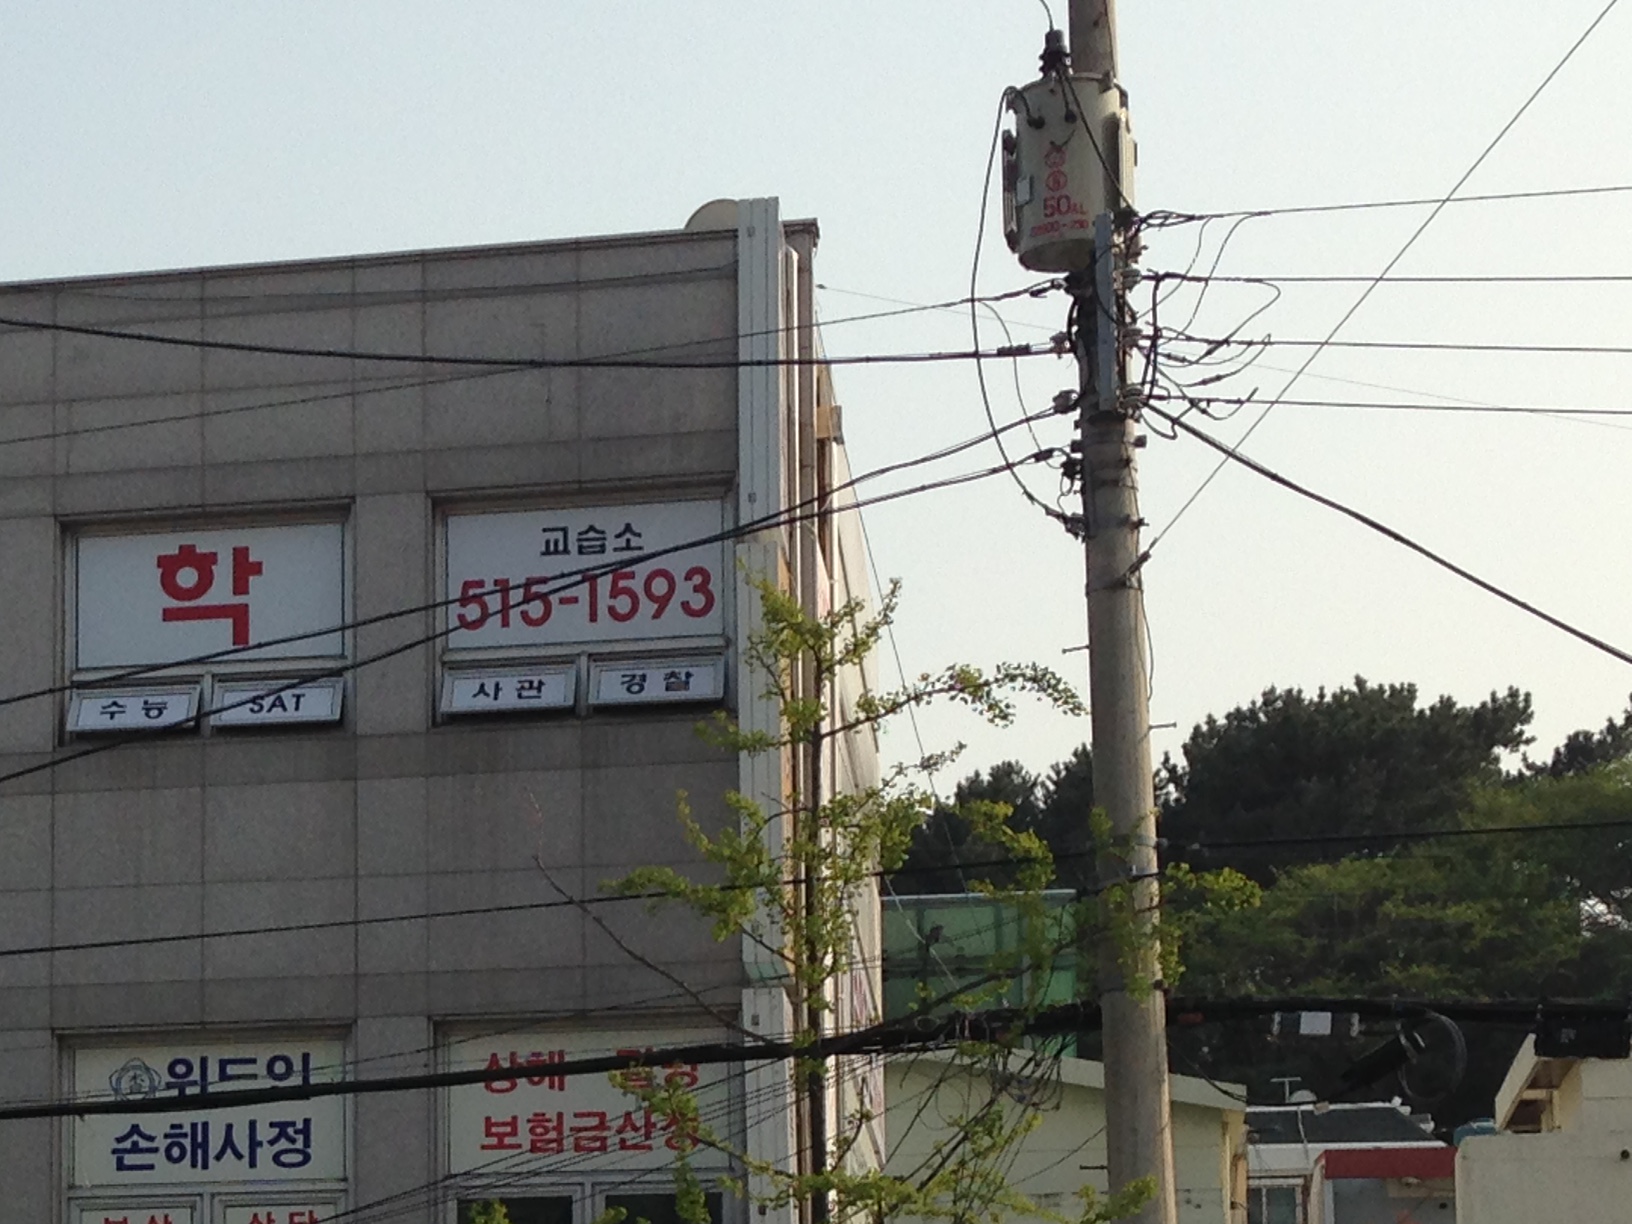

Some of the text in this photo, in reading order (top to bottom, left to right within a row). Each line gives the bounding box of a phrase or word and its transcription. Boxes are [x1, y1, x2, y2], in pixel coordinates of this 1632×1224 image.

[540, 522, 644, 556] 교습소
[157, 544, 263, 646] 학
[458, 566, 716, 630] 515-1593
[472, 678, 546, 701] 사관
[621, 670, 694, 695] 경찰
[99, 695, 168, 721] 수능
[248, 692, 306, 714] SAT
[111, 1117, 312, 1171] 손해사정
